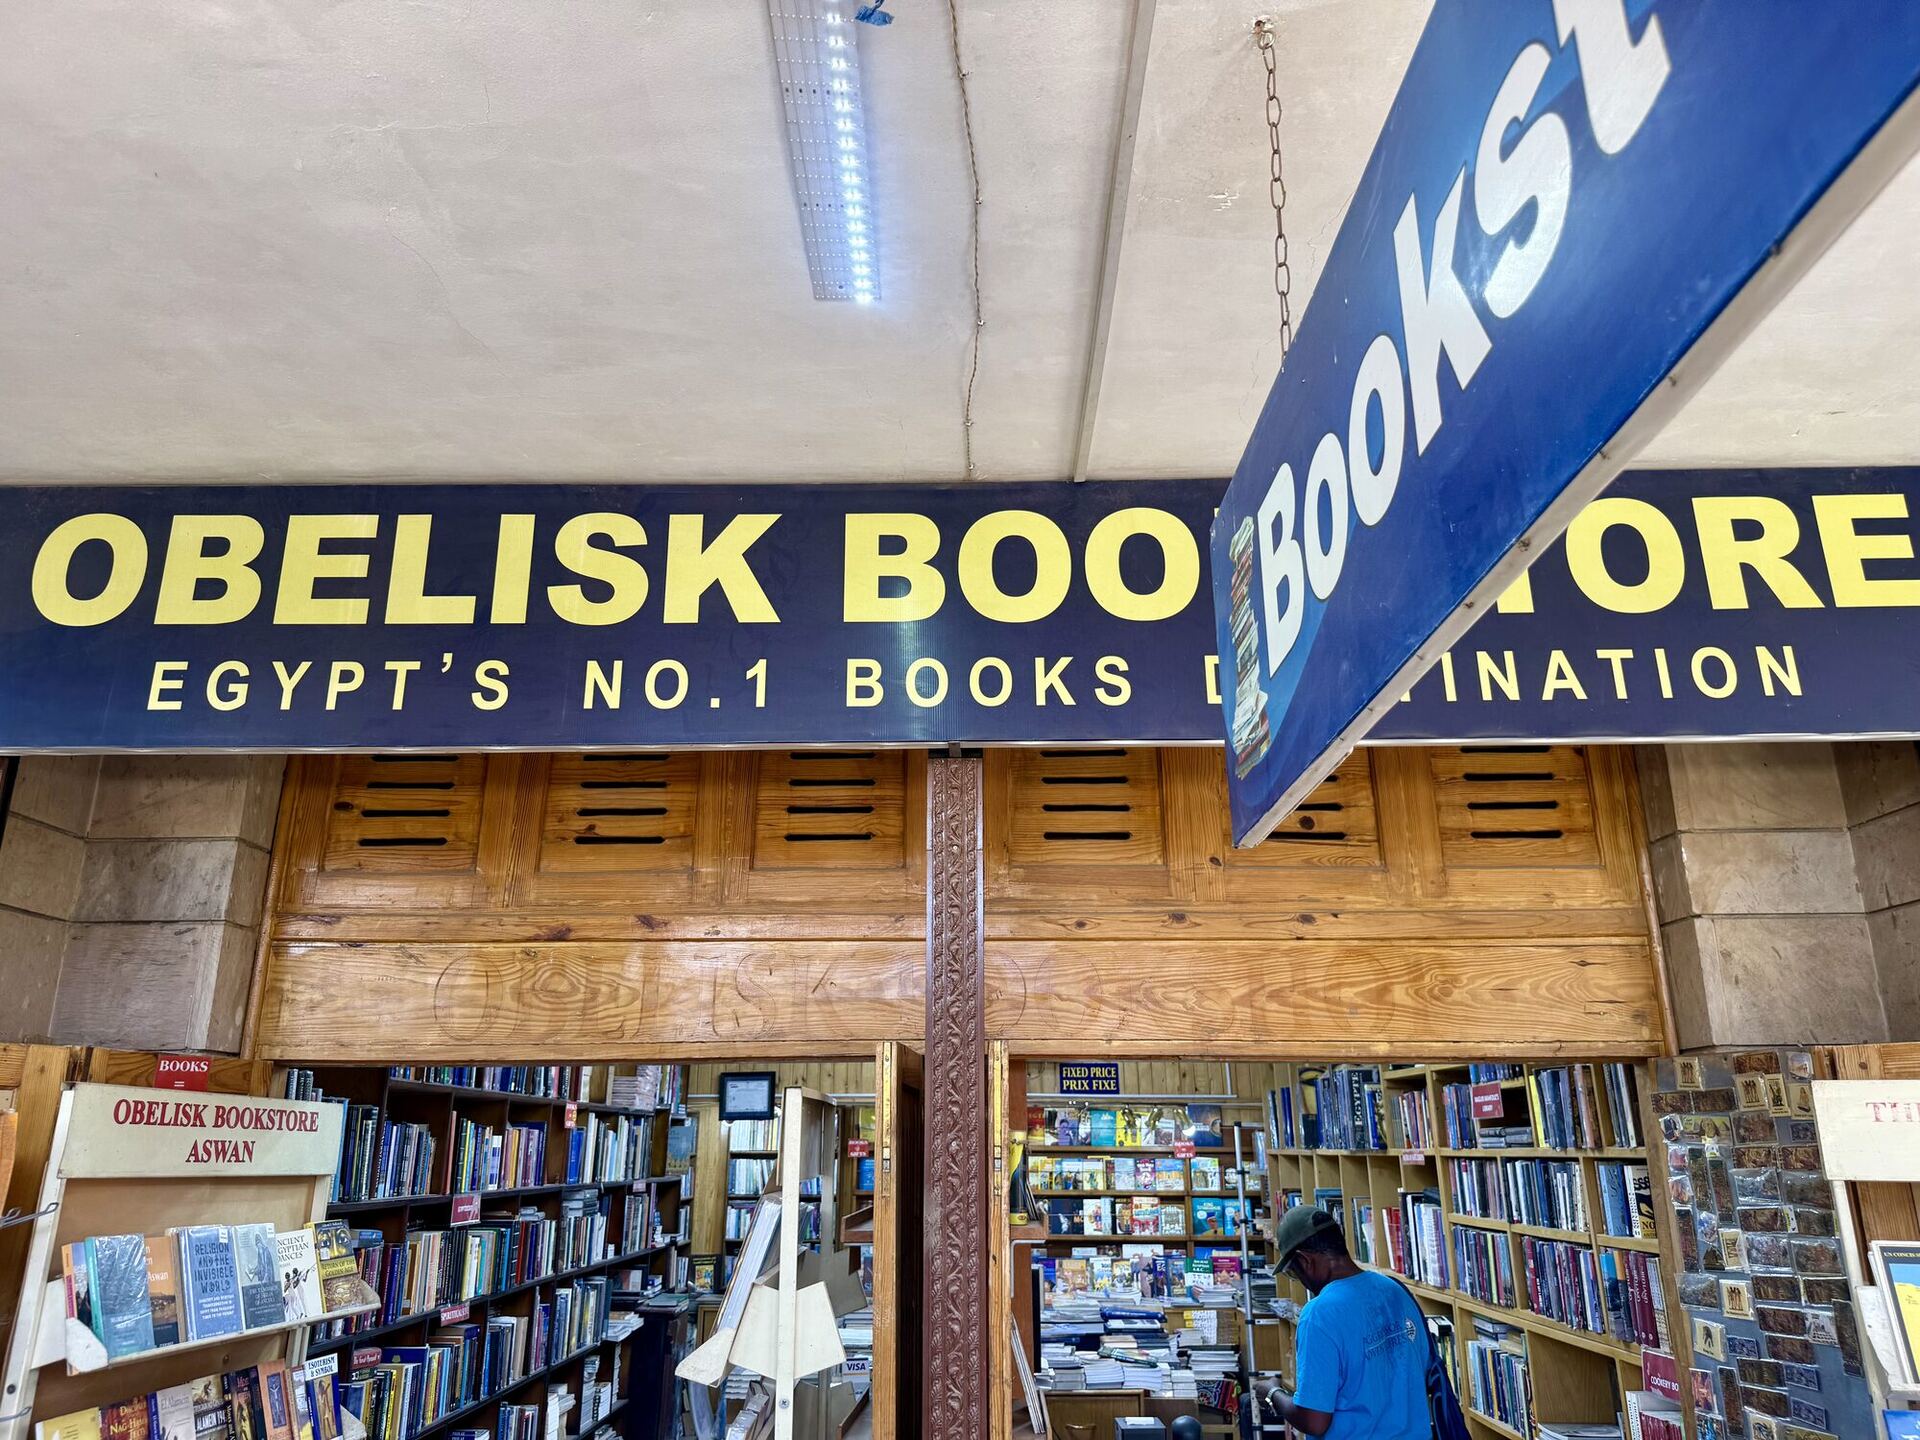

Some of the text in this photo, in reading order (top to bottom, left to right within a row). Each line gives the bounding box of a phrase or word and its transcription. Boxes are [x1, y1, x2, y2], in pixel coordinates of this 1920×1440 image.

[32, 494, 1920, 626] OBELISK BOOORE
[148, 646, 1803, 711] EGYPT’S NO.1 BOOKS INATION
[159, 1060, 209, 1073] BOOKS
[1062, 1067, 1117, 1078] FIXED PRICE
[1062, 1080, 1117, 1091] PRIX FIXE
[1351, 1072, 1363, 1125] EGYPTE
[113, 1098, 320, 1133] OBELISK BOOKSTORE
[186, 1140, 256, 1163] ASWAN
[277, 1235, 306, 1248] NCIENT
[195, 1242, 230, 1255] RELIGION
[277, 1242, 309, 1255] GYPTIAN
[194, 1266, 234, 1282] INVISIBLE
[200, 1280, 231, 1294] WORLD
[308, 1356, 335, 1370] ESOTERISM
[847, 1363, 866, 1371] VISA
[315, 1365, 333, 1376] SYMBOL
[1651, 1376, 1671, 1389] COOKERY
